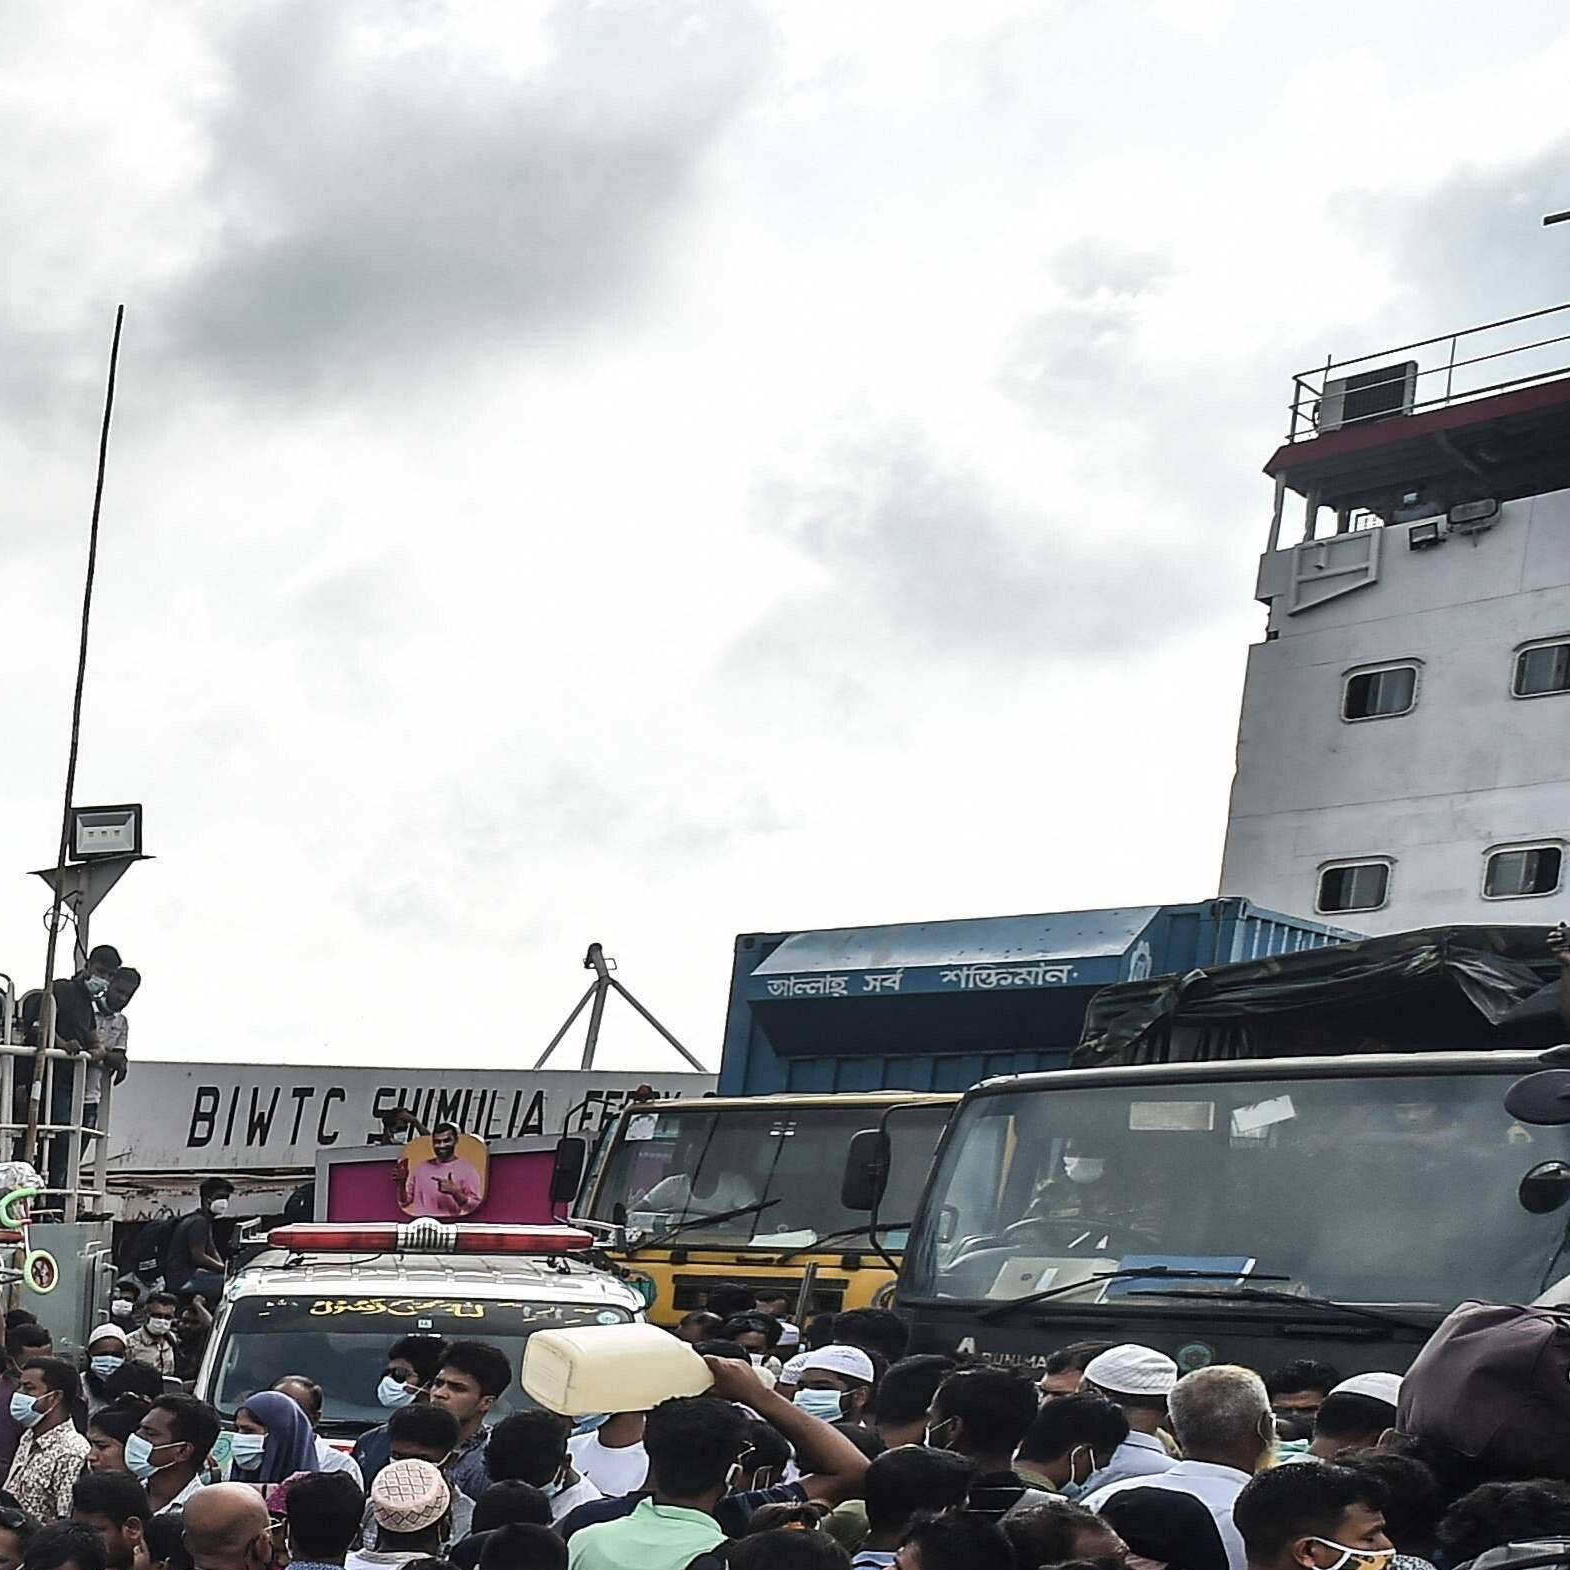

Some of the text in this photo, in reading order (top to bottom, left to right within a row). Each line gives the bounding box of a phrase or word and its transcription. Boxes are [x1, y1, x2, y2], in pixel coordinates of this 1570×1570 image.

[862, 968, 906, 993] সর্ব
[186, 1086, 346, 1149] BIWTC
[366, 1086, 545, 1146] SHIMULIA
